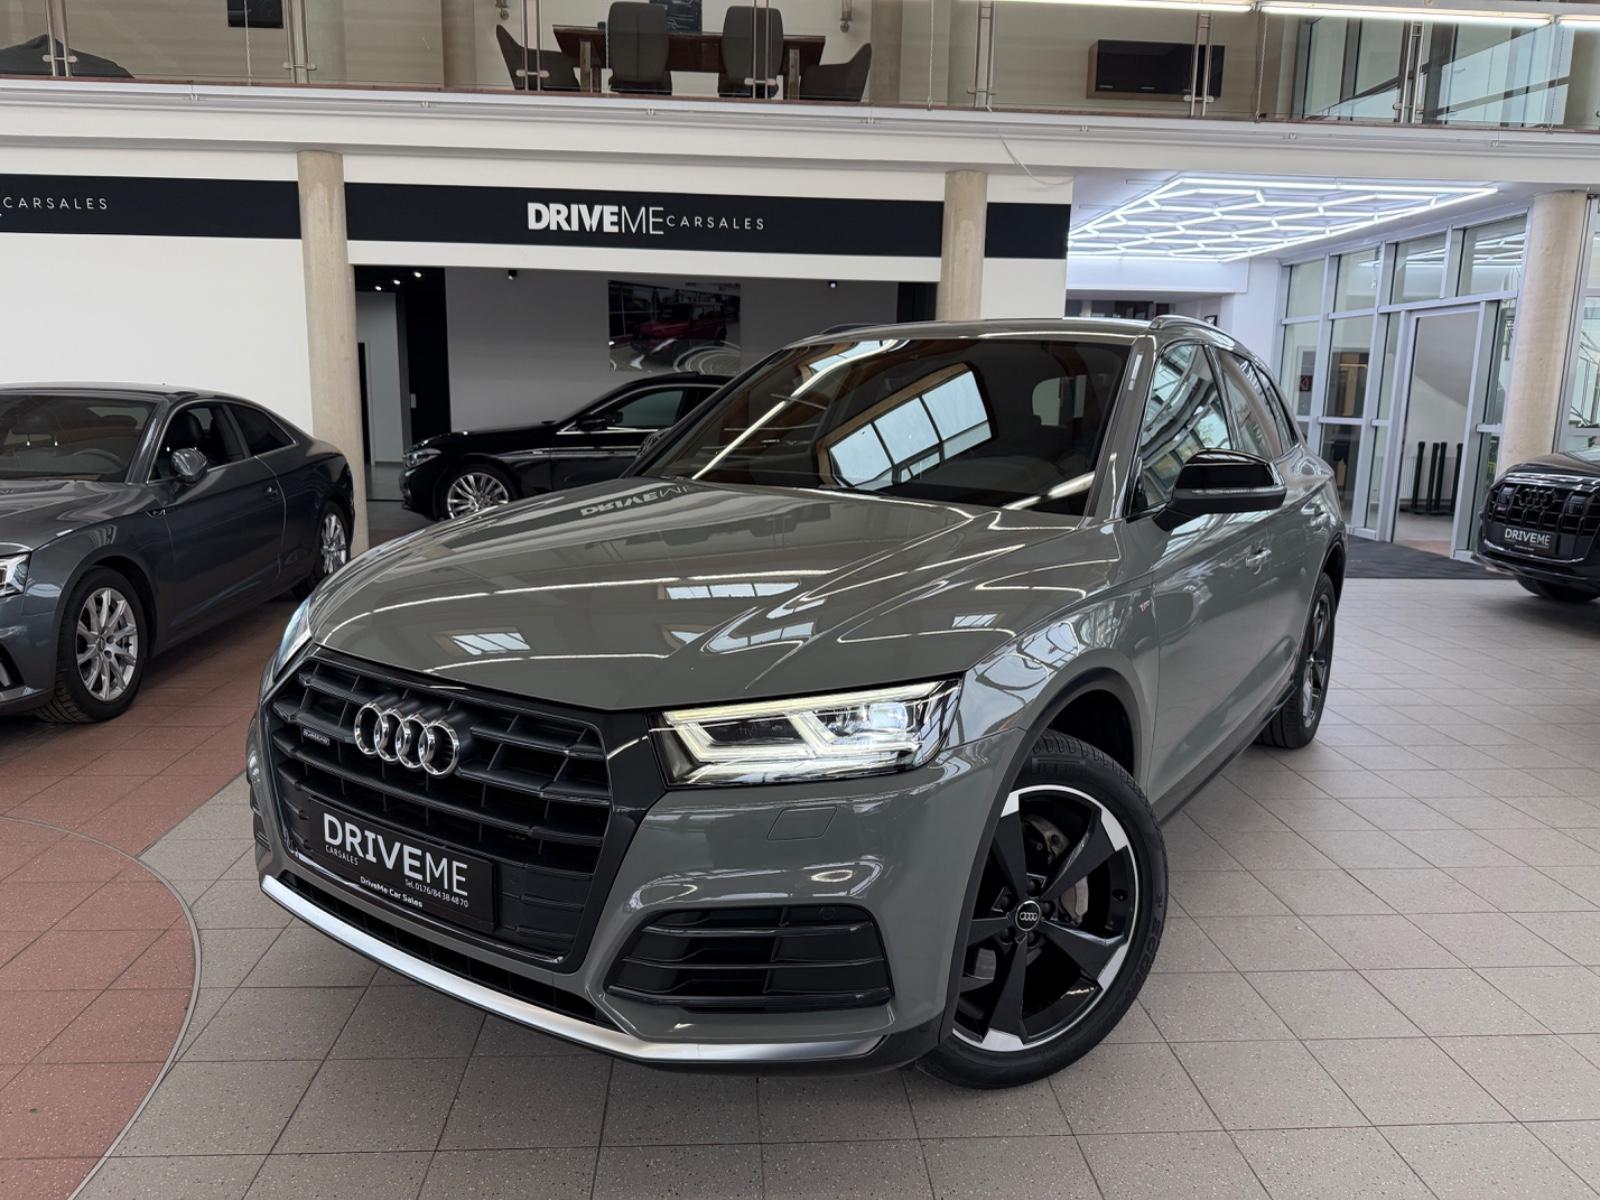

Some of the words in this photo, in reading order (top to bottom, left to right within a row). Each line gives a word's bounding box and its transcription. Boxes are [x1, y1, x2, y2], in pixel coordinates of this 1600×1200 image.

[3, 196, 108, 210] CARSALES
[527, 202, 664, 235] DRIVEME
[666, 214, 765, 230] CARSALES
[1504, 527, 1551, 546] DRIVEME
[323, 812, 468, 897] DRIVEME
[325, 844, 359, 866] CARSALES
[389, 888, 402, 899] Car
[402, 893, 423, 908] Sales
